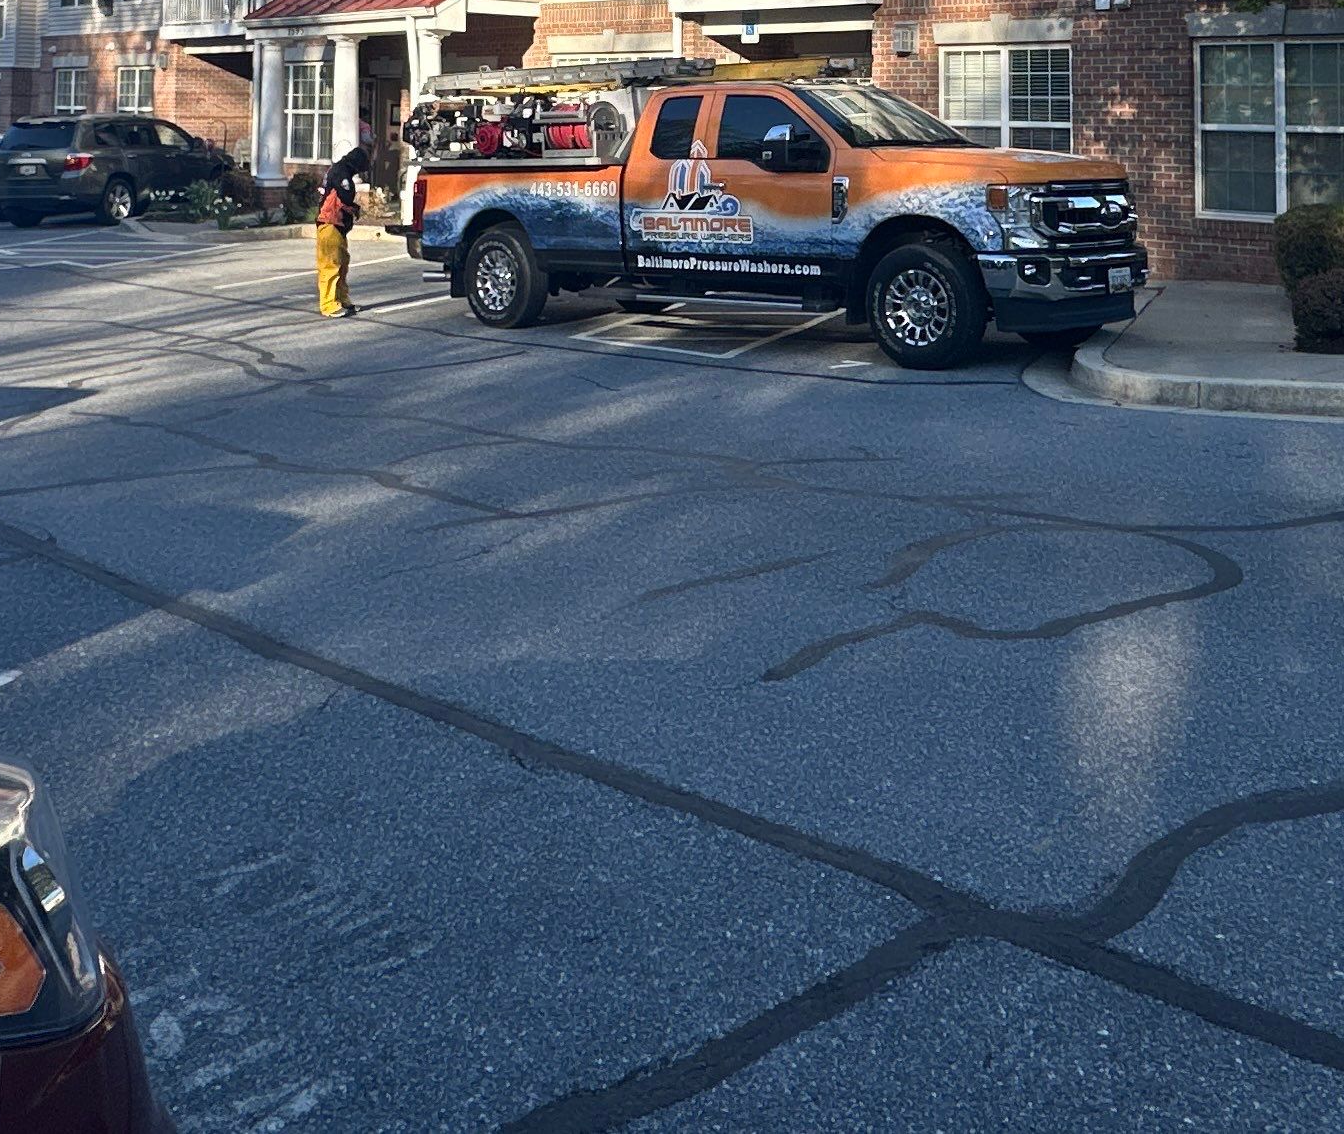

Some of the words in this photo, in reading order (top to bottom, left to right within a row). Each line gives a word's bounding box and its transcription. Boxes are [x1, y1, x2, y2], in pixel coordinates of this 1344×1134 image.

[529, 180, 617, 197] 443-531-6660
[643, 216, 752, 233] BALTIMORE
[644, 231, 698, 240] PRESSURE
[700, 233, 752, 242] WASHERS
[637, 254, 822, 276] BaltimorePressureWashers.com
